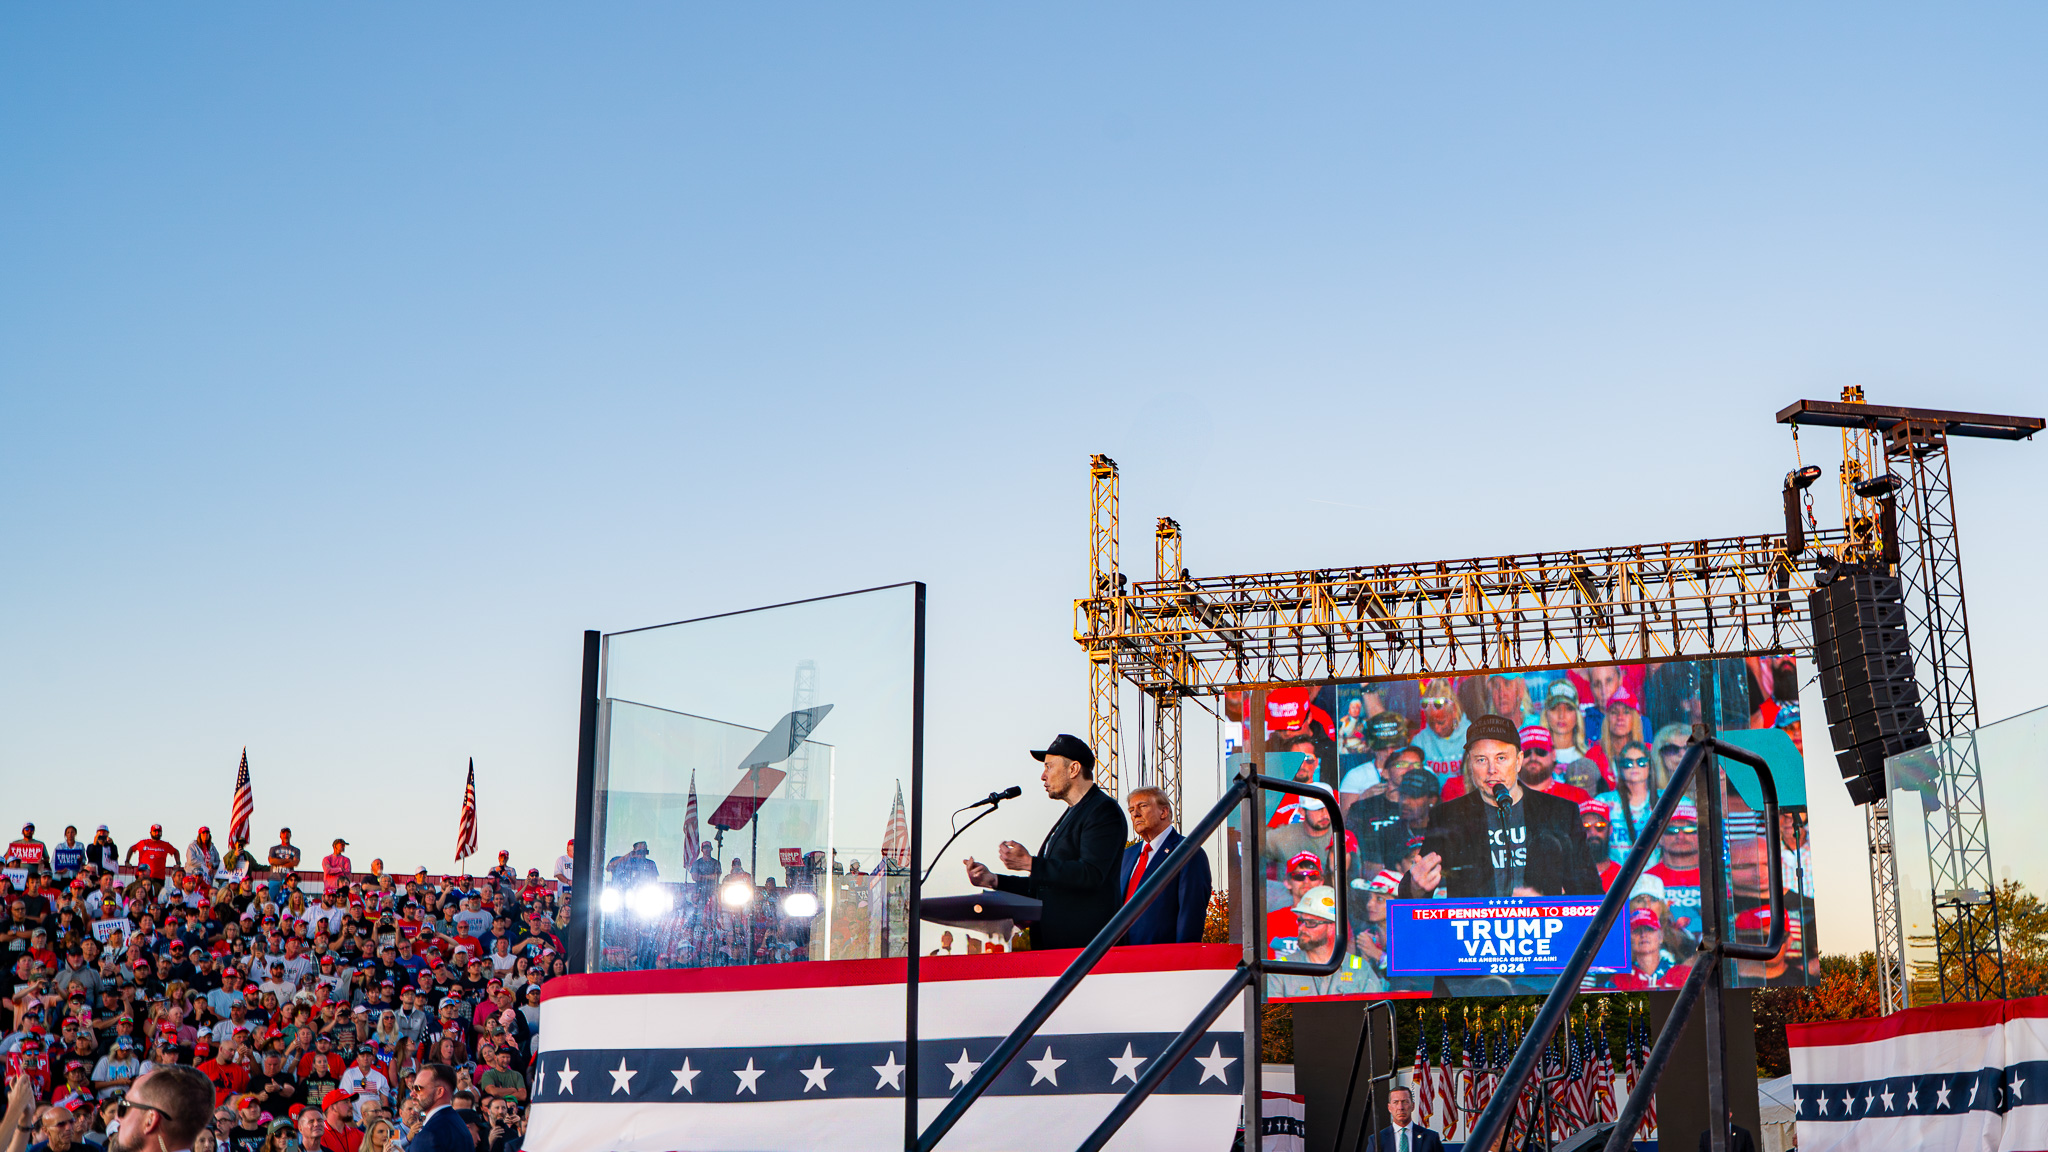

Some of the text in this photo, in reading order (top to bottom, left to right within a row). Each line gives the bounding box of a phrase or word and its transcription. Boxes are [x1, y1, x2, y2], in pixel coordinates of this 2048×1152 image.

[11, 846, 41, 855] TRUMP
[1414, 905, 1599, 920] TEXT PENNSYLVANIA TO 88022
[98, 921, 124, 931] FIGHT!
[1451, 918, 1563, 940] TRUMP
[1464, 938, 1550, 957] VANCE
[1490, 963, 1525, 974] 2024
